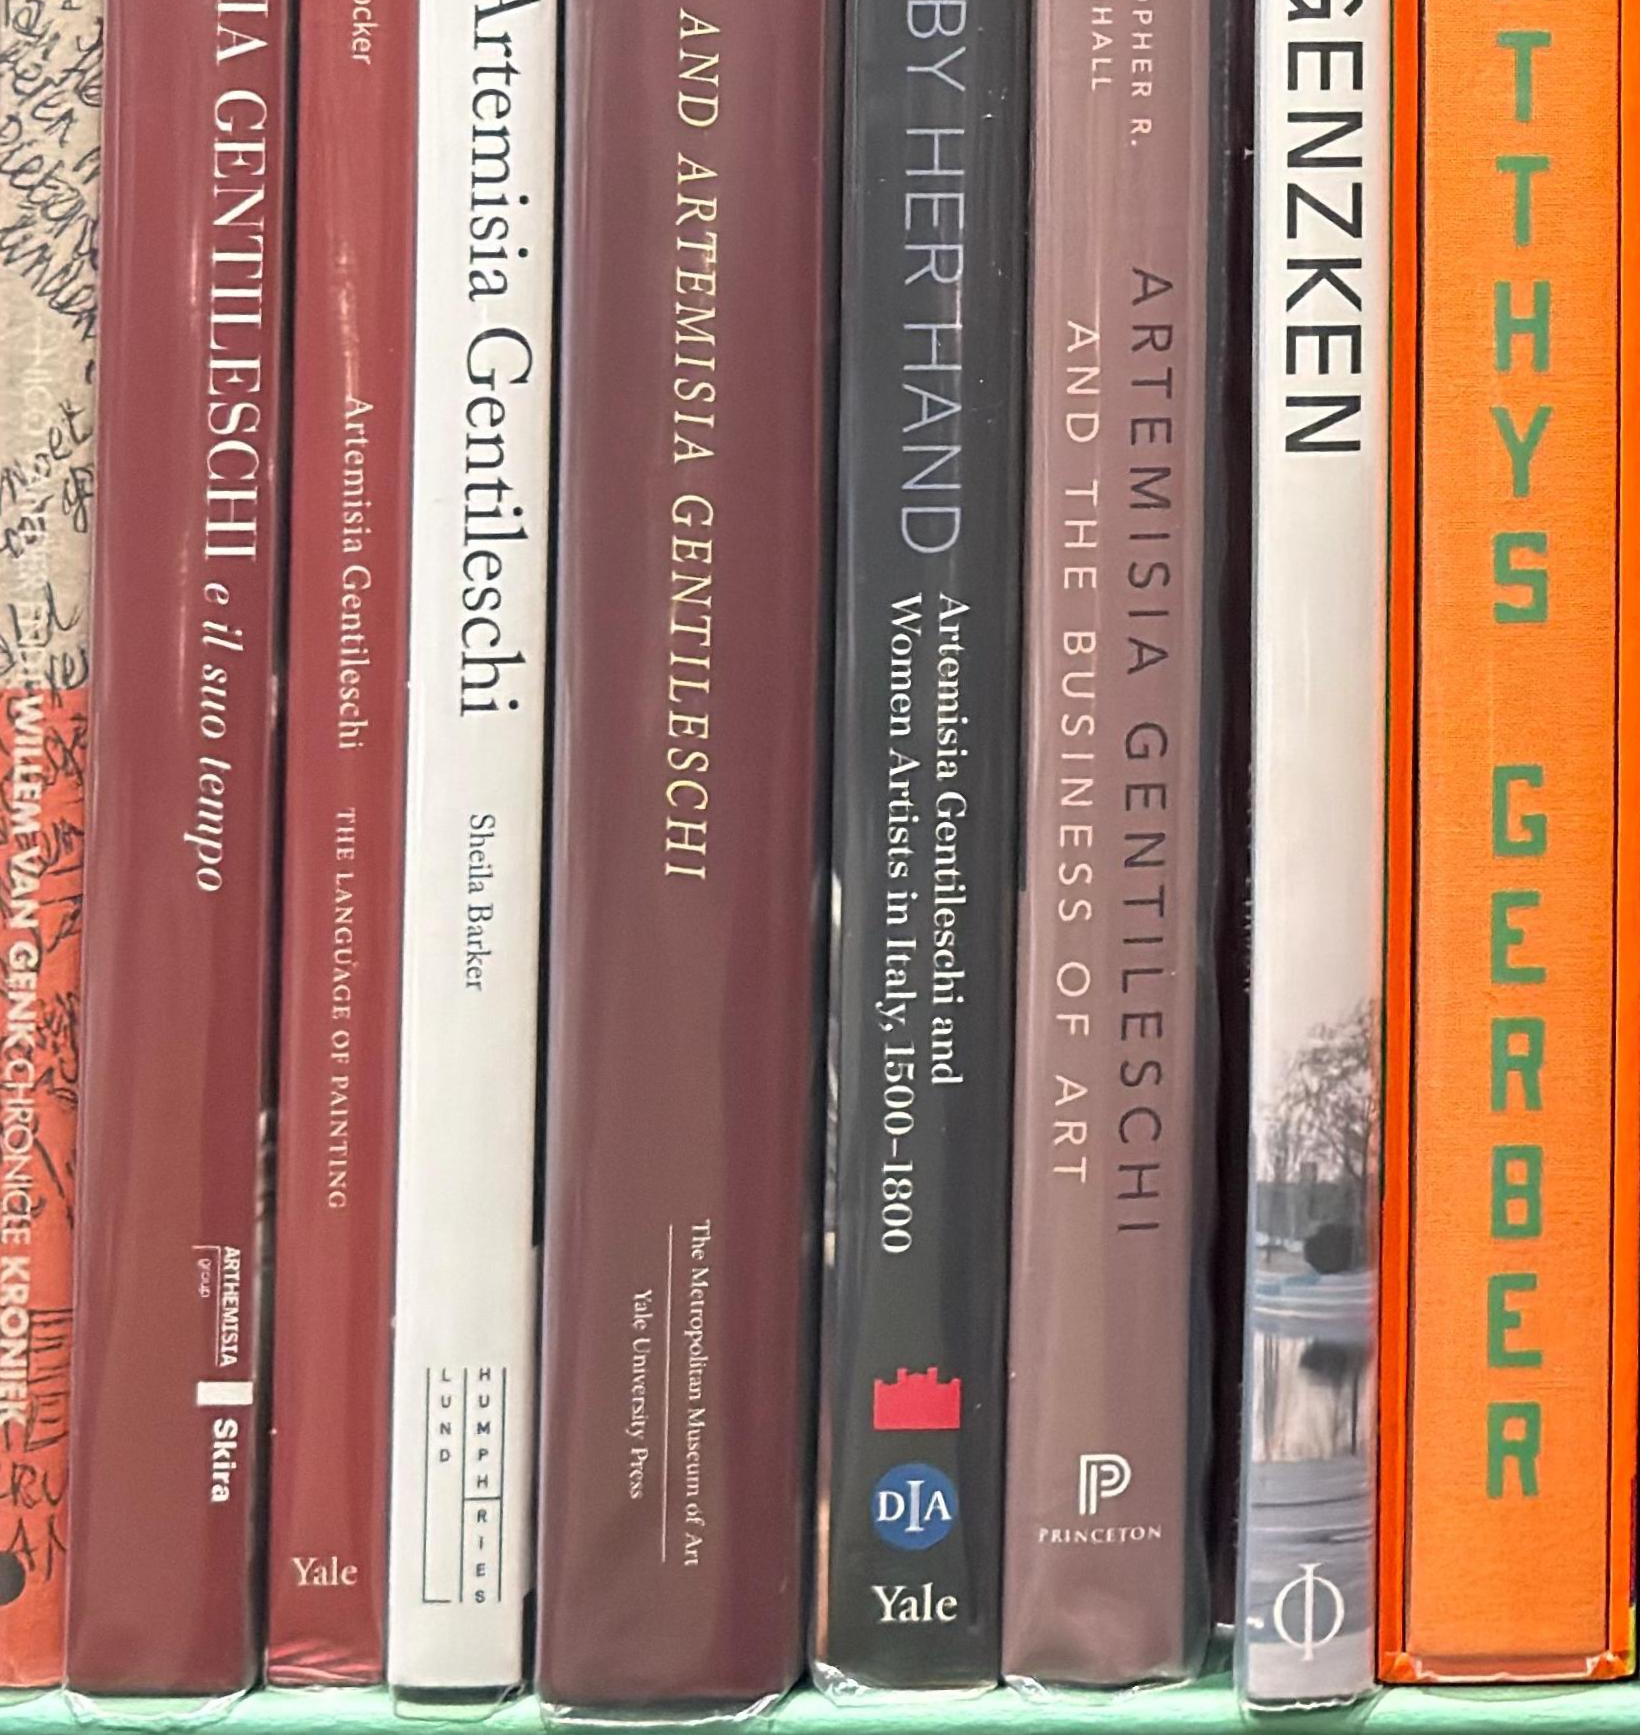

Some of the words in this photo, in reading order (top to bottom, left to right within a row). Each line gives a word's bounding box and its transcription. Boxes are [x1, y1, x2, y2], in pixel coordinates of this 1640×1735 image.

[678, 11, 719, 128] AND
[1131, 119, 1151, 148] R.
[902, 127, 966, 284] HER
[202, 88, 267, 563] GENTILESCHI
[672, 154, 716, 465] ARTEMISIA
[900, 320, 962, 554] HAND
[1064, 320, 1099, 444] AND
[341, 396, 372, 554] Artemisia
[457, 326, 535, 717] Gentileschi
[1125, 266, 1174, 675] ARTEMISIA
[1063, 480, 1099, 591] THE
[200, 618, 244, 650] il
[203, 582, 230, 606] e
[198, 664, 230, 739] suo
[337, 564, 372, 749] Gentileschi
[665, 495, 712, 882] GENTILESCHI
[888, 593, 924, 738] Women
[936, 593, 970, 781] Artemisia
[12, 694, 43, 836] WILLEM
[885, 748, 920, 879] Artists
[1057, 630, 1097, 924] BUSINESS
[185, 754, 232, 892] tempo
[335, 808, 357, 861] THE
[464, 813, 496, 894] Sheila
[8, 846, 42, 937] VAN
[332, 871, 356, 1020] LANGUAGE
[462, 902, 493, 991] Barker
[885, 891, 918, 926] in
[932, 791, 965, 1005] Gentileschi
[5, 942, 39, 1053] GENK
[877, 937, 916, 1031] Italy,
[1056, 961, 1092, 1037] OF
[1118, 722, 1169, 1236] GENTILESCHI
[331, 1030, 351, 1064] OF
[931, 1016, 963, 1085] and
[1, 1059, 35, 1246] CHRONICLE
[327, 1075, 351, 1209] PAINTING
[1052, 1074, 1088, 1184] ART
[1486, 763, 1548, 1498] GERBER
[198, 1258, 213, 1298] group
[688, 1220, 712, 1260] The
[1, 1256, 32, 1427] KRONIEK
[218, 1246, 241, 1368] ARTHEMISIA
[631, 1289, 654, 1330] Yale
[681, 1268, 708, 1401] Metropolitan
[624, 1336, 654, 1441] University
[210, 1418, 239, 1503] Skira
[627, 1449, 650, 1498] Press
[684, 1408, 707, 1497] Museum
[682, 1532, 705, 1566] Art
[684, 1504, 706, 1526] of
[1038, 1527, 1162, 1542] PRINCETON
[290, 1556, 359, 1587] Yale
[871, 1584, 958, 1625] Yale
